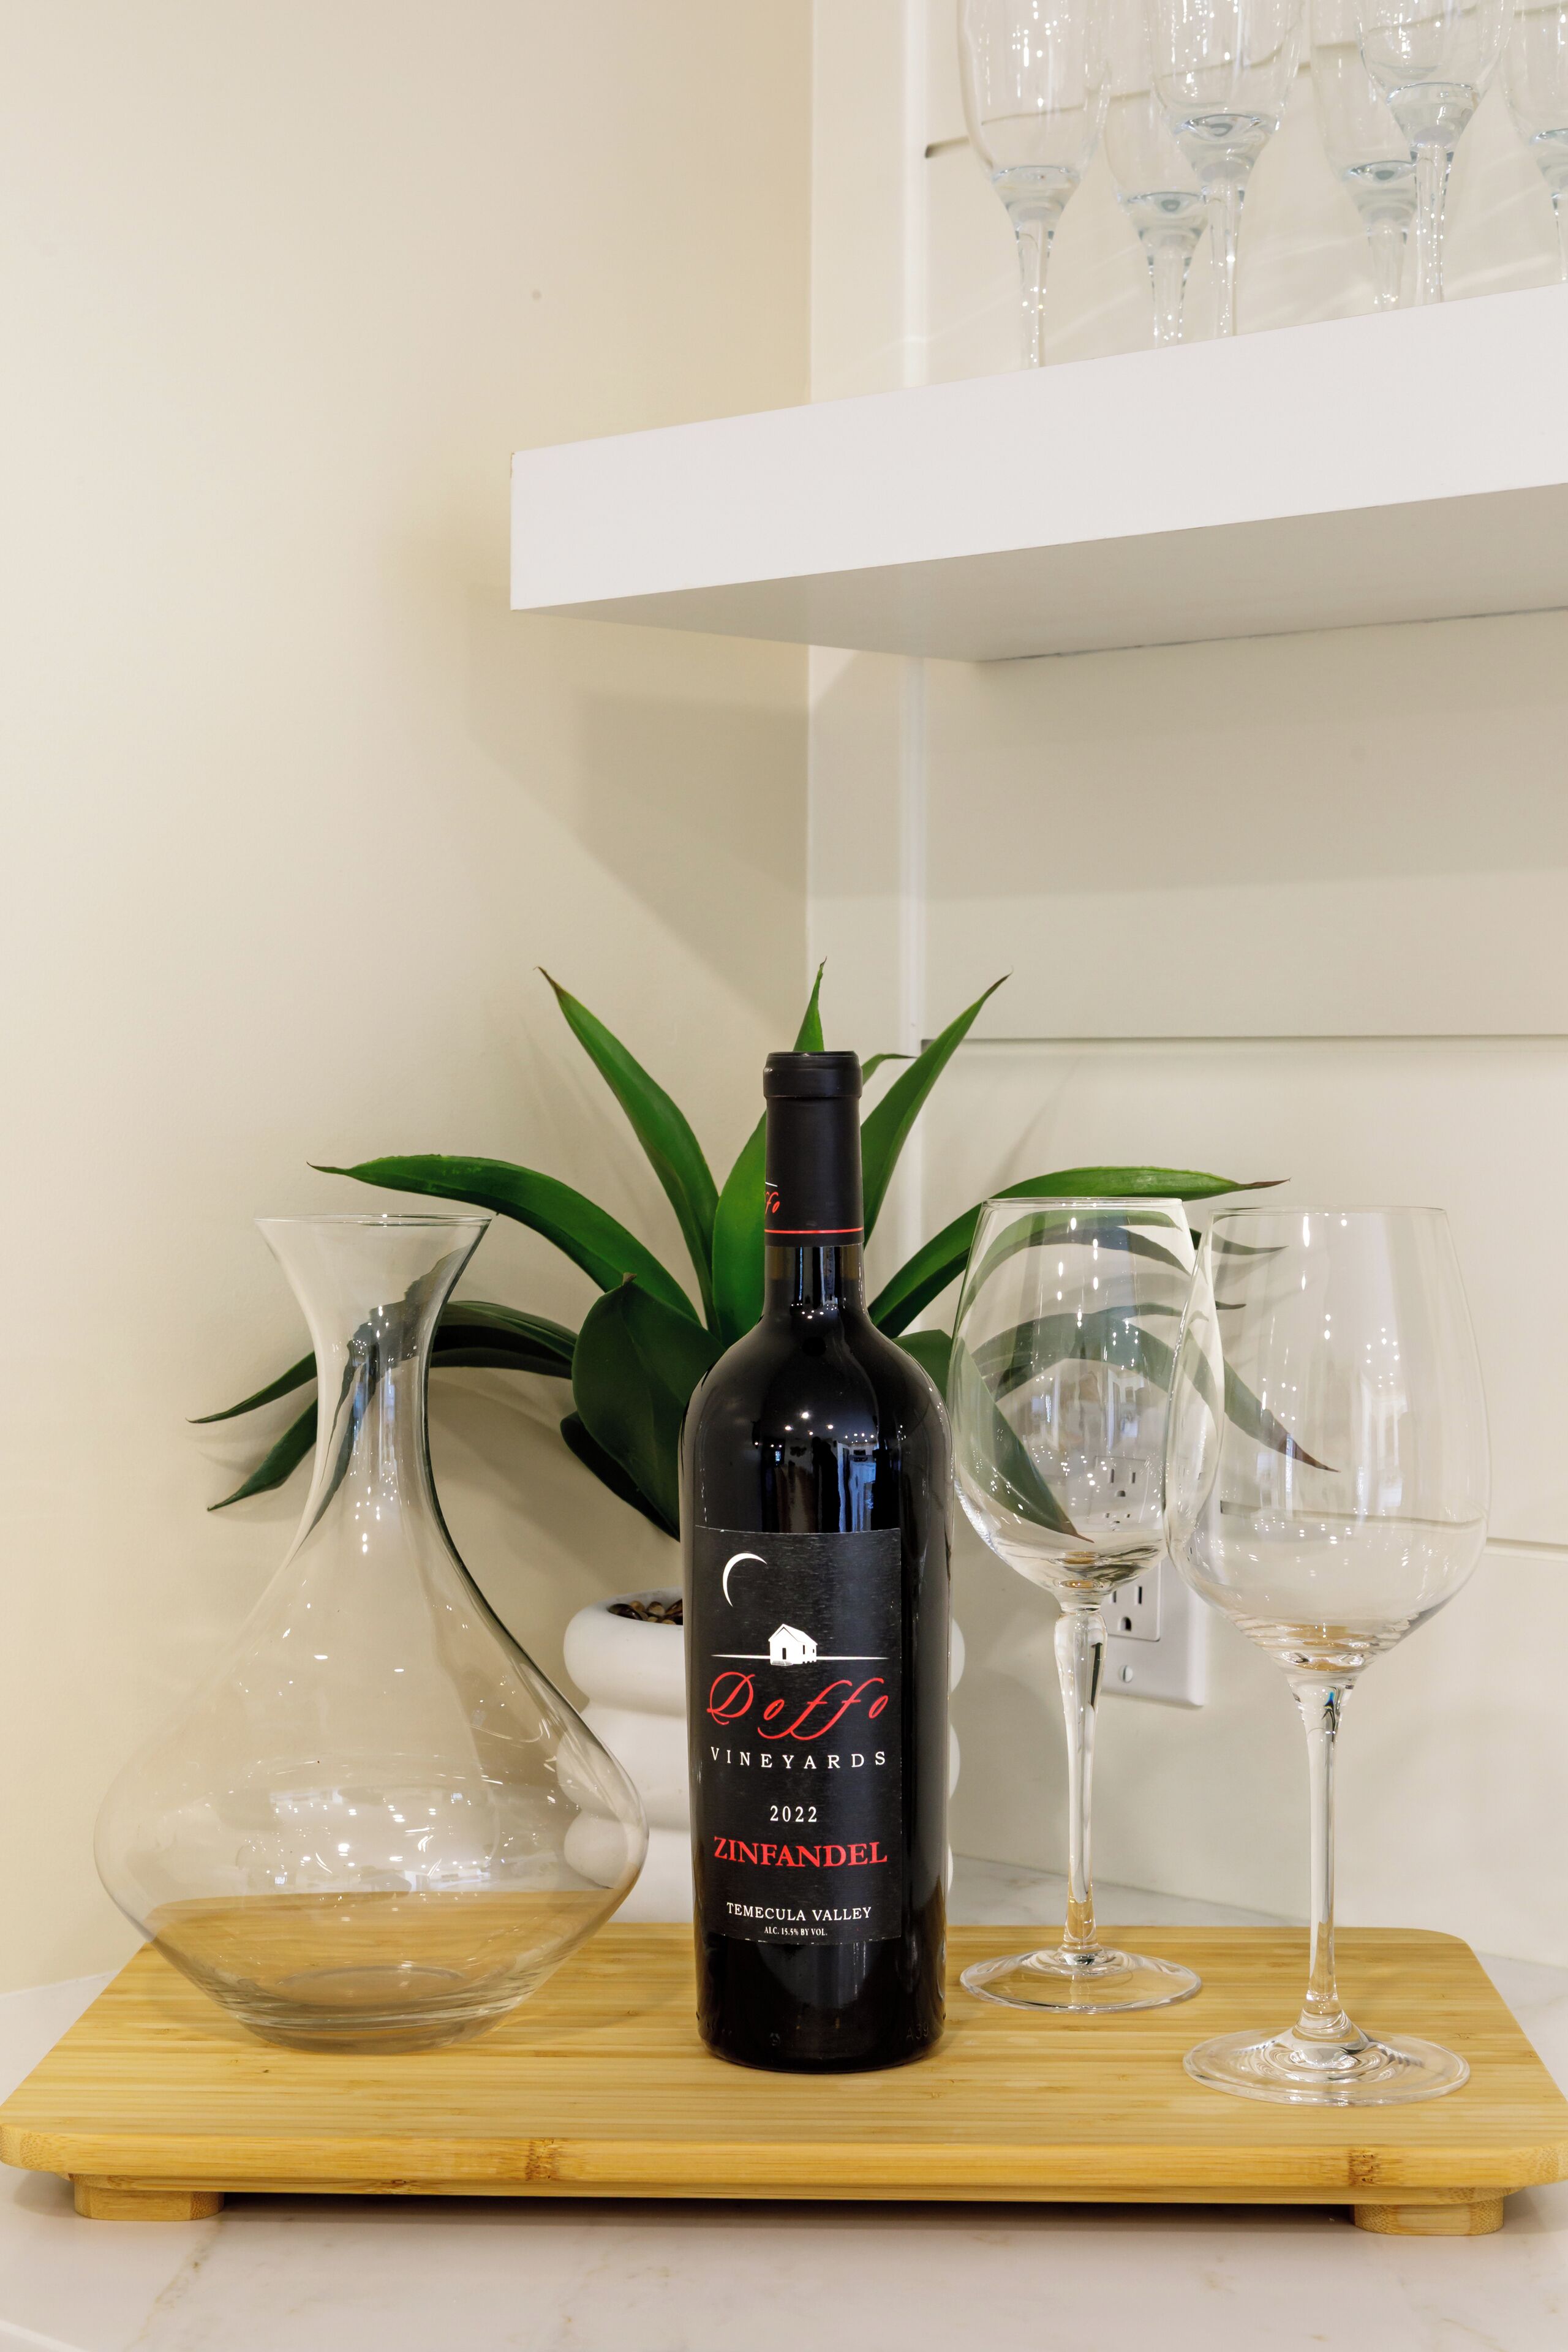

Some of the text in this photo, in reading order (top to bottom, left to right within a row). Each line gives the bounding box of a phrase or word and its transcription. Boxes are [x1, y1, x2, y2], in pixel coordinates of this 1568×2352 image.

[707, 1672, 889, 1741] Doffo
[710, 1746, 886, 1770] VINEYARDS
[770, 1805, 817, 1823] 2022
[714, 1836, 888, 1868] ZINFANDEL
[726, 1902, 872, 1921] TEMECULA VALLEY
